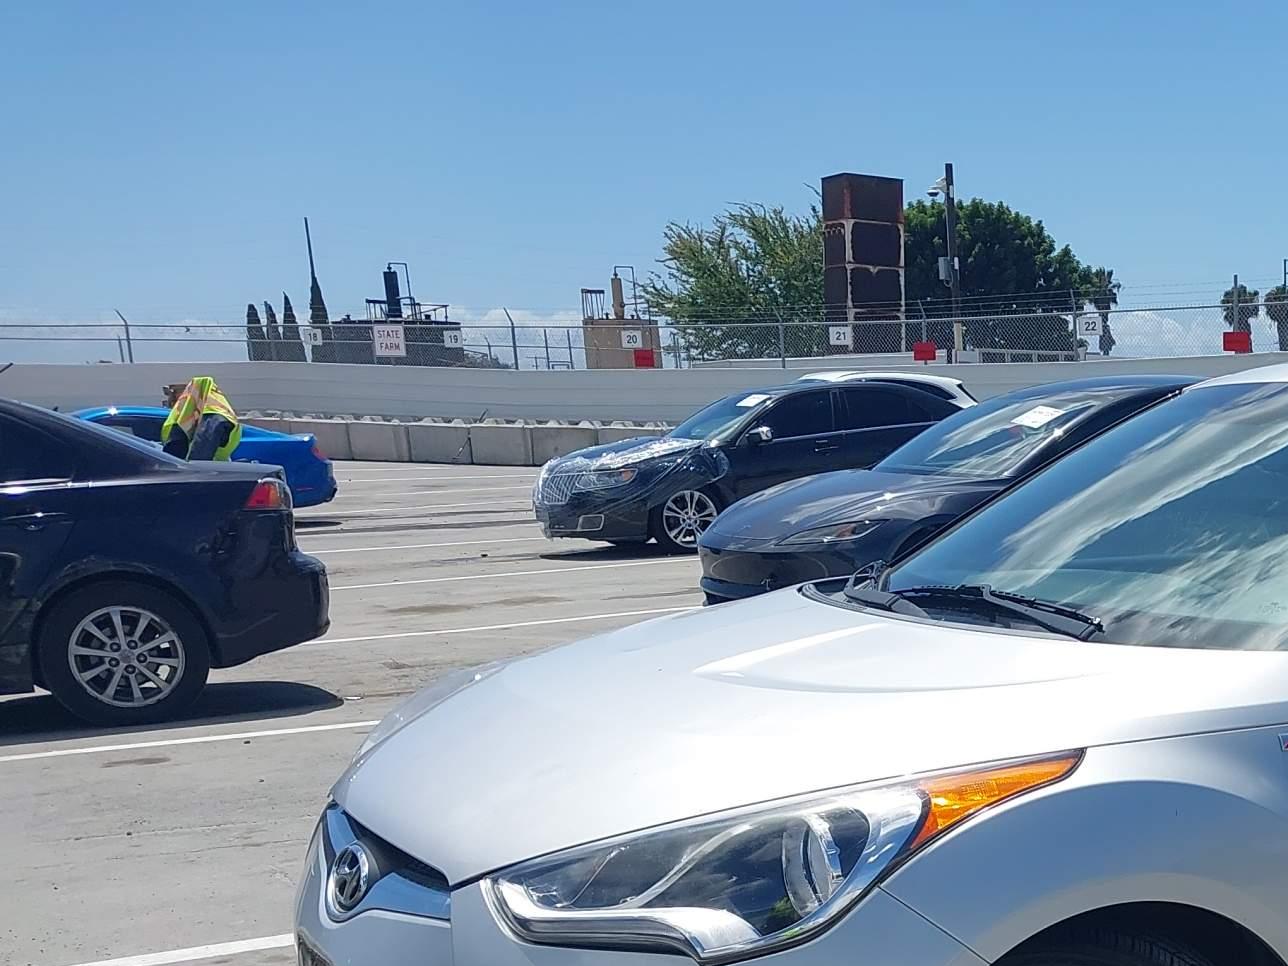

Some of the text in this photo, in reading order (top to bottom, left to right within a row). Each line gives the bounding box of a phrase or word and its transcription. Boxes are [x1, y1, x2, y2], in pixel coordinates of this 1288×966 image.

[1084, 320, 1098, 332] 22
[307, 330, 318, 342] 18
[376, 329, 401, 340] STATE
[448, 334, 459, 344] 19
[626, 334, 638, 345] 20
[834, 331, 847, 341] 21
[379, 342, 401, 352] FARM
